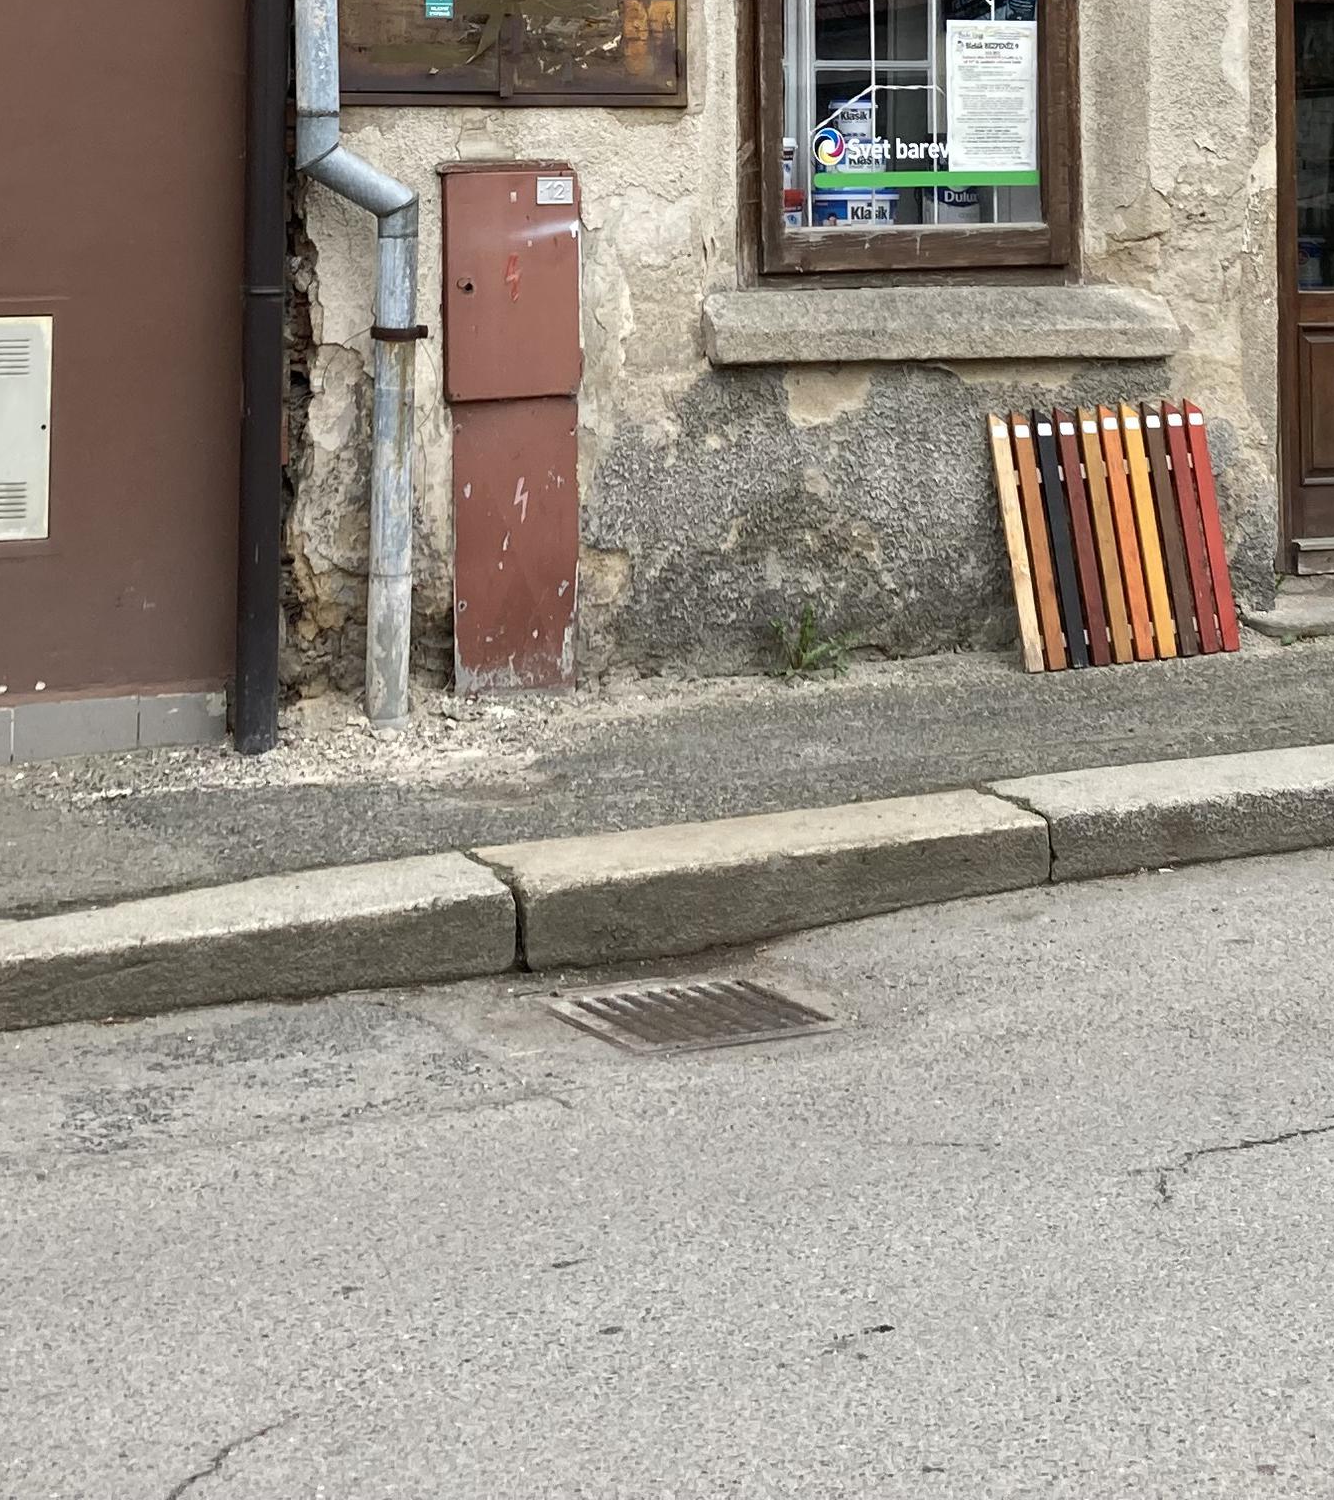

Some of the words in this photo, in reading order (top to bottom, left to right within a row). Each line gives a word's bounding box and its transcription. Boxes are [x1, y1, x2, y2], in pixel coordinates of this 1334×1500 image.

[840, 110, 868, 120] Klasik
[847, 135, 891, 160] Svět
[896, 138, 948, 160] barev
